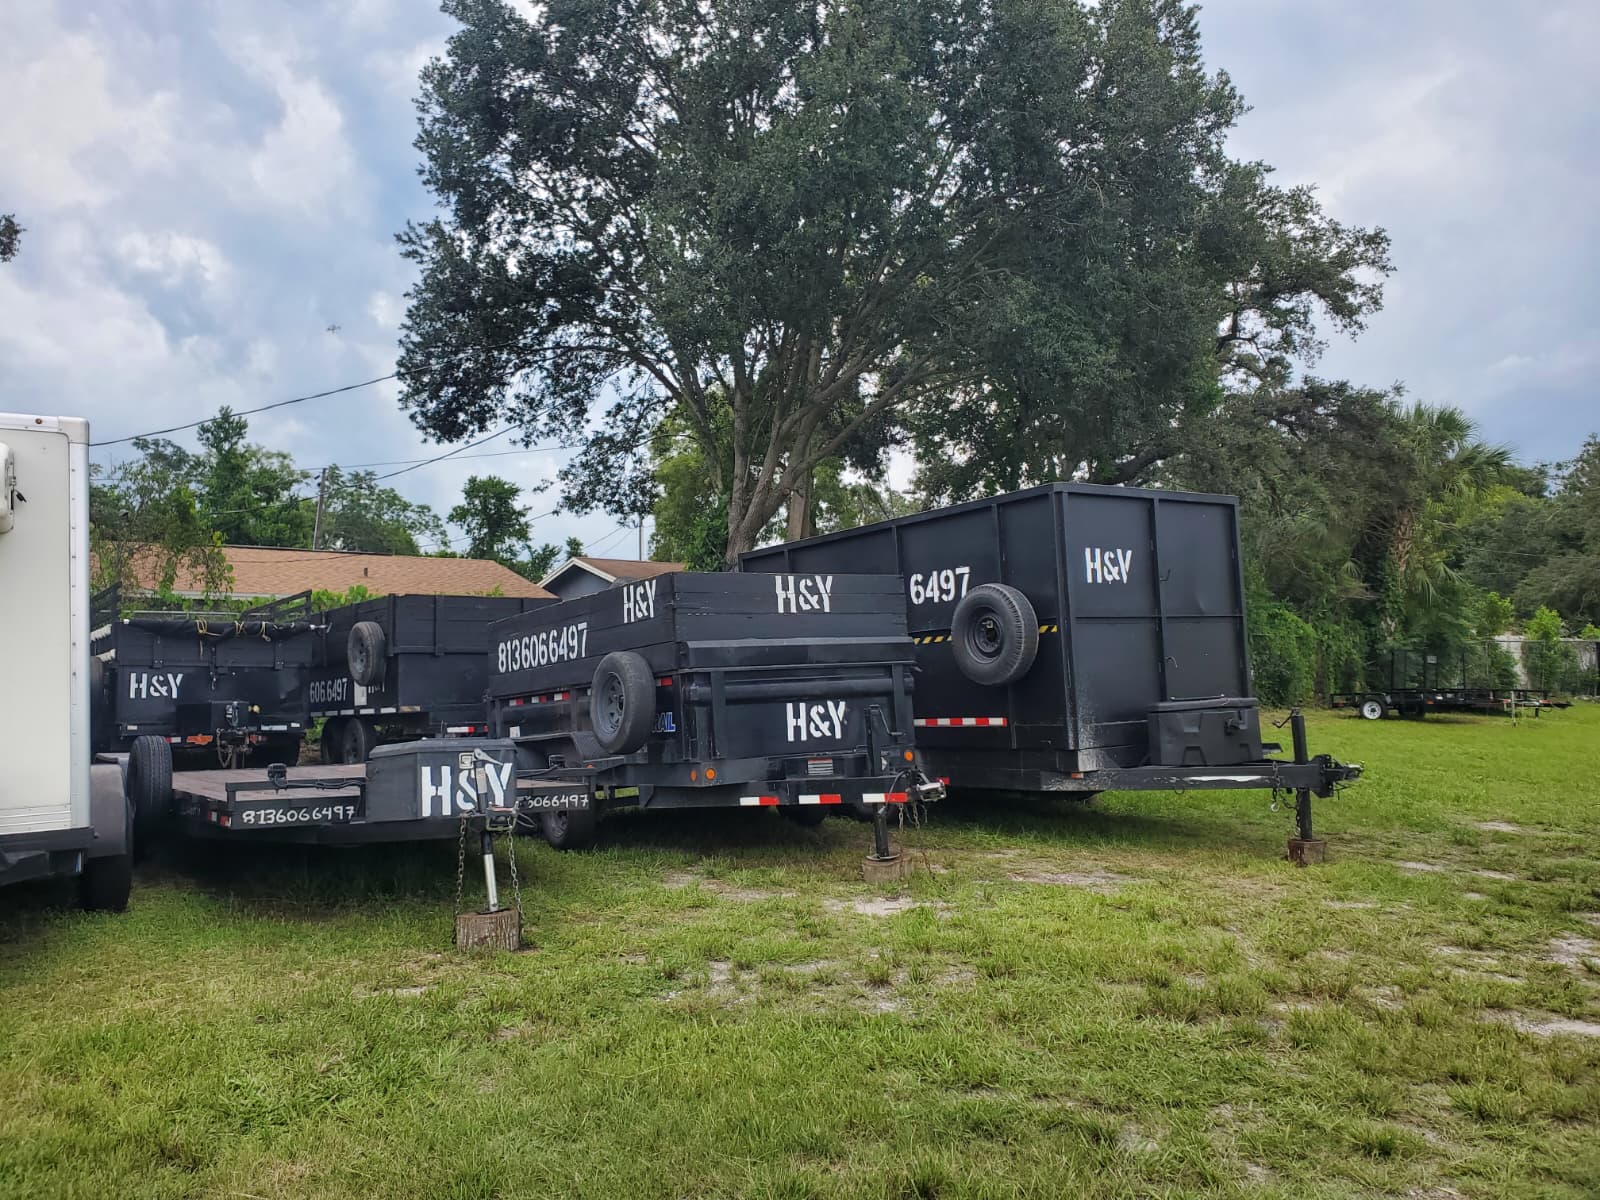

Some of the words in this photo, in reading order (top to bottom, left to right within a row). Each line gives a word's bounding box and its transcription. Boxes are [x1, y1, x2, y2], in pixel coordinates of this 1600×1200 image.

[1085, 547, 1132, 584] H&Y
[622, 579, 657, 623] H&Y
[775, 575, 833, 613] H&Y
[909, 566, 970, 605] 6497
[498, 621, 588, 673] 8136066497
[129, 672, 183, 699] H&Y
[786, 700, 846, 742] H&Y
[242, 806, 355, 825] 8136066497
